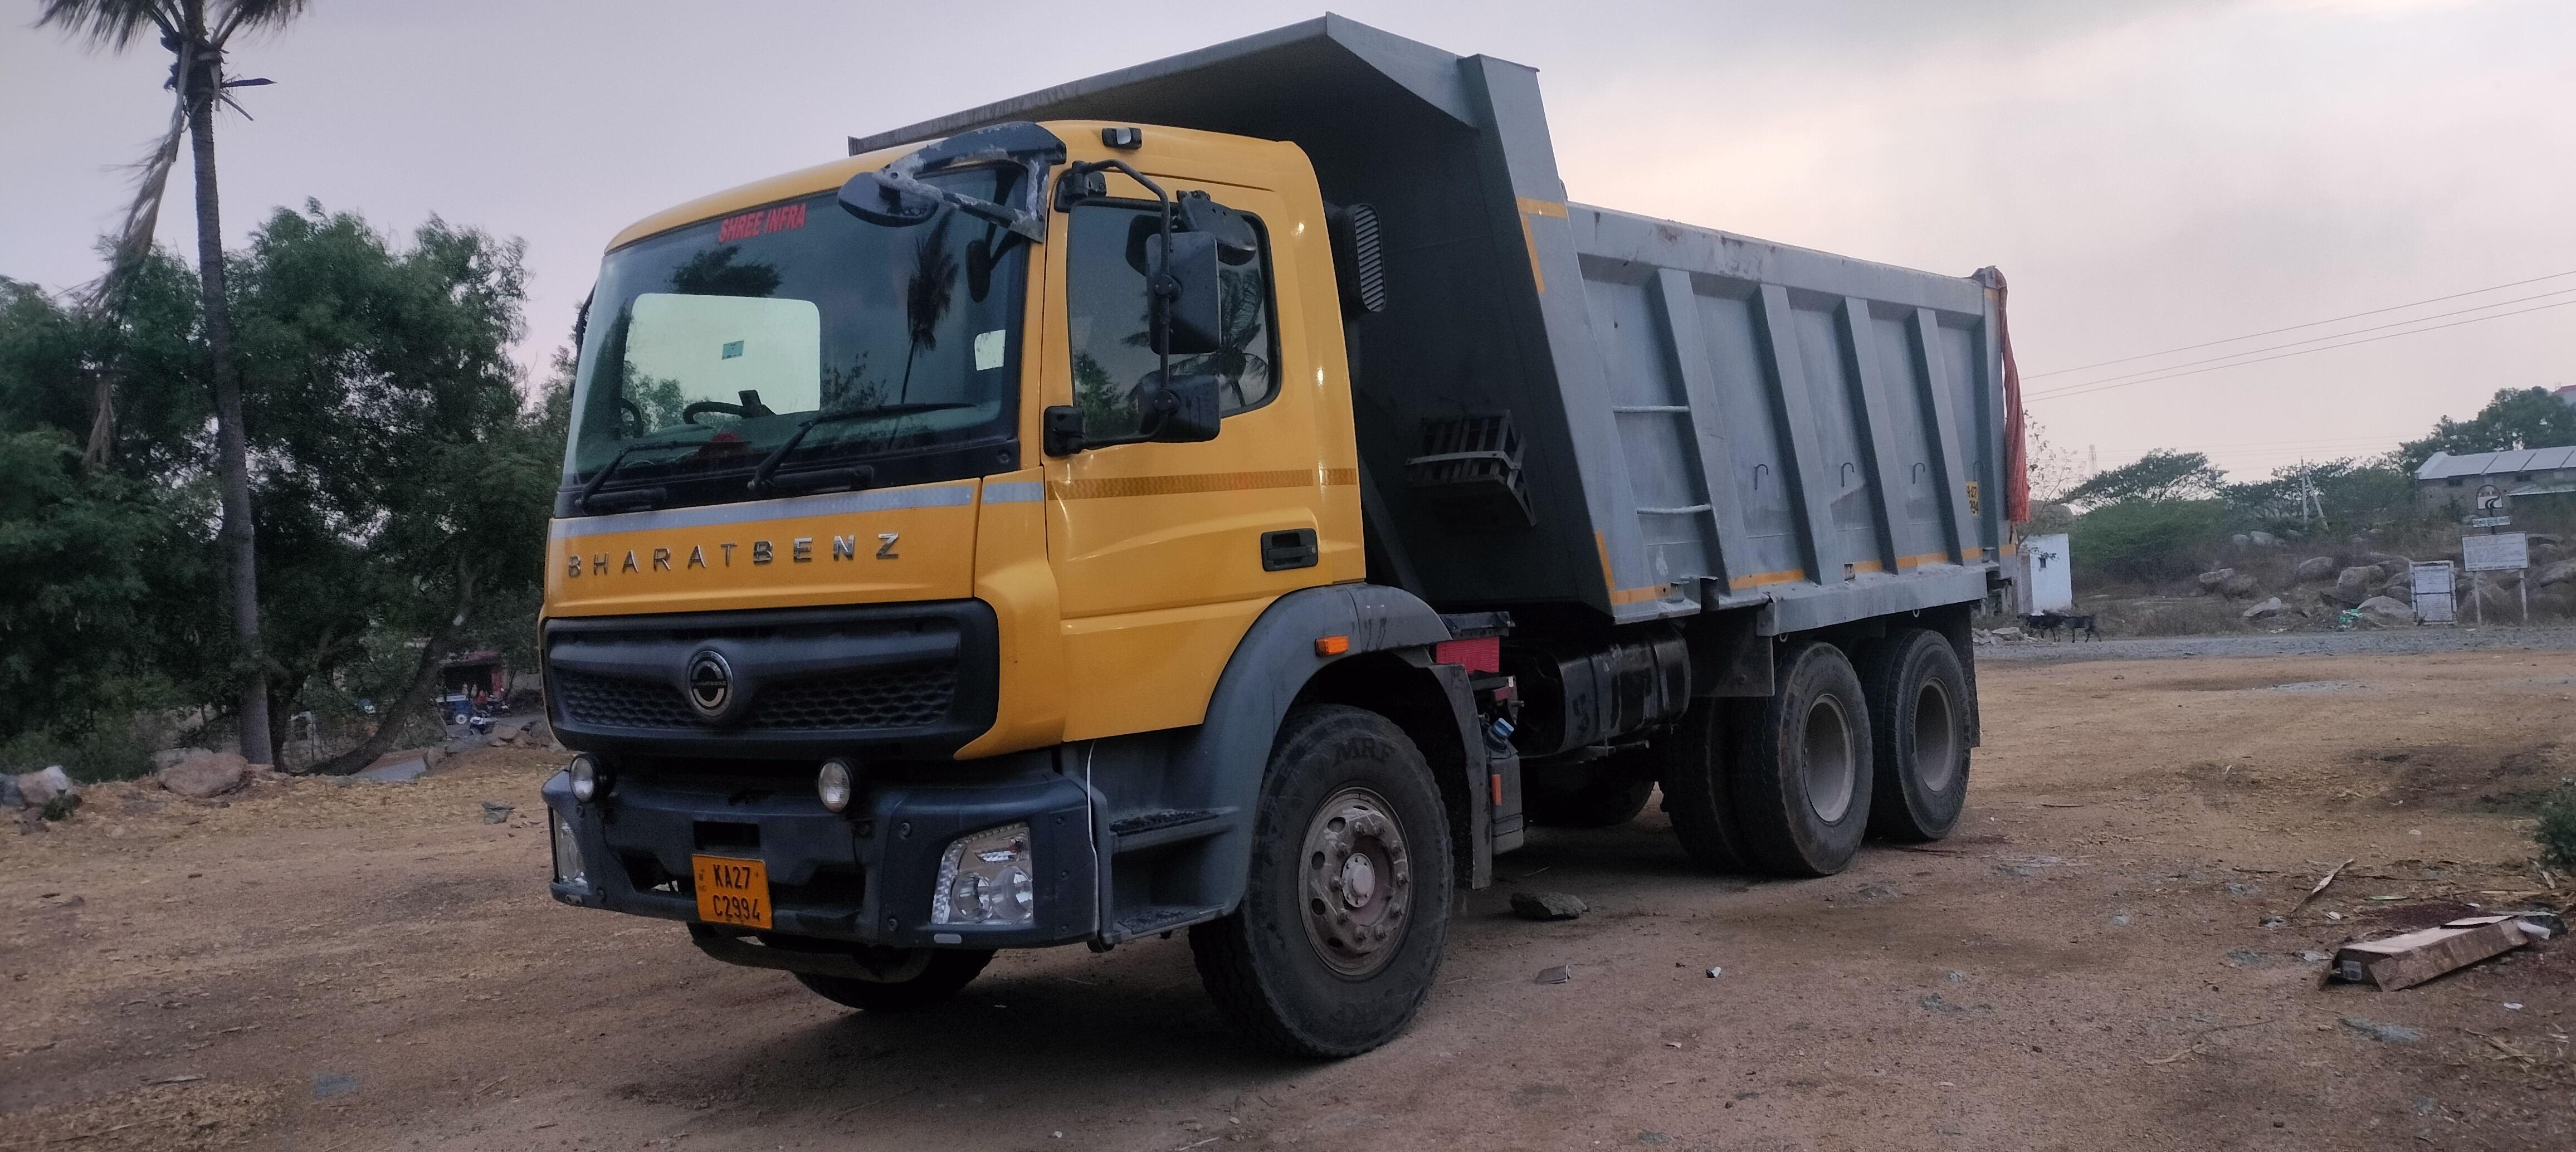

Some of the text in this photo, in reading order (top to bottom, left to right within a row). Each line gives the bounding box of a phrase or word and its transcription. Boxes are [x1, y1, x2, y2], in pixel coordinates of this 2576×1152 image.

[719, 203, 806, 243] SHREE INFRA
[568, 531, 900, 578] BHARATBENZ
[1332, 737, 1396, 768] MRF
[713, 863, 750, 890] KA27
[713, 894, 760, 921] C2994
